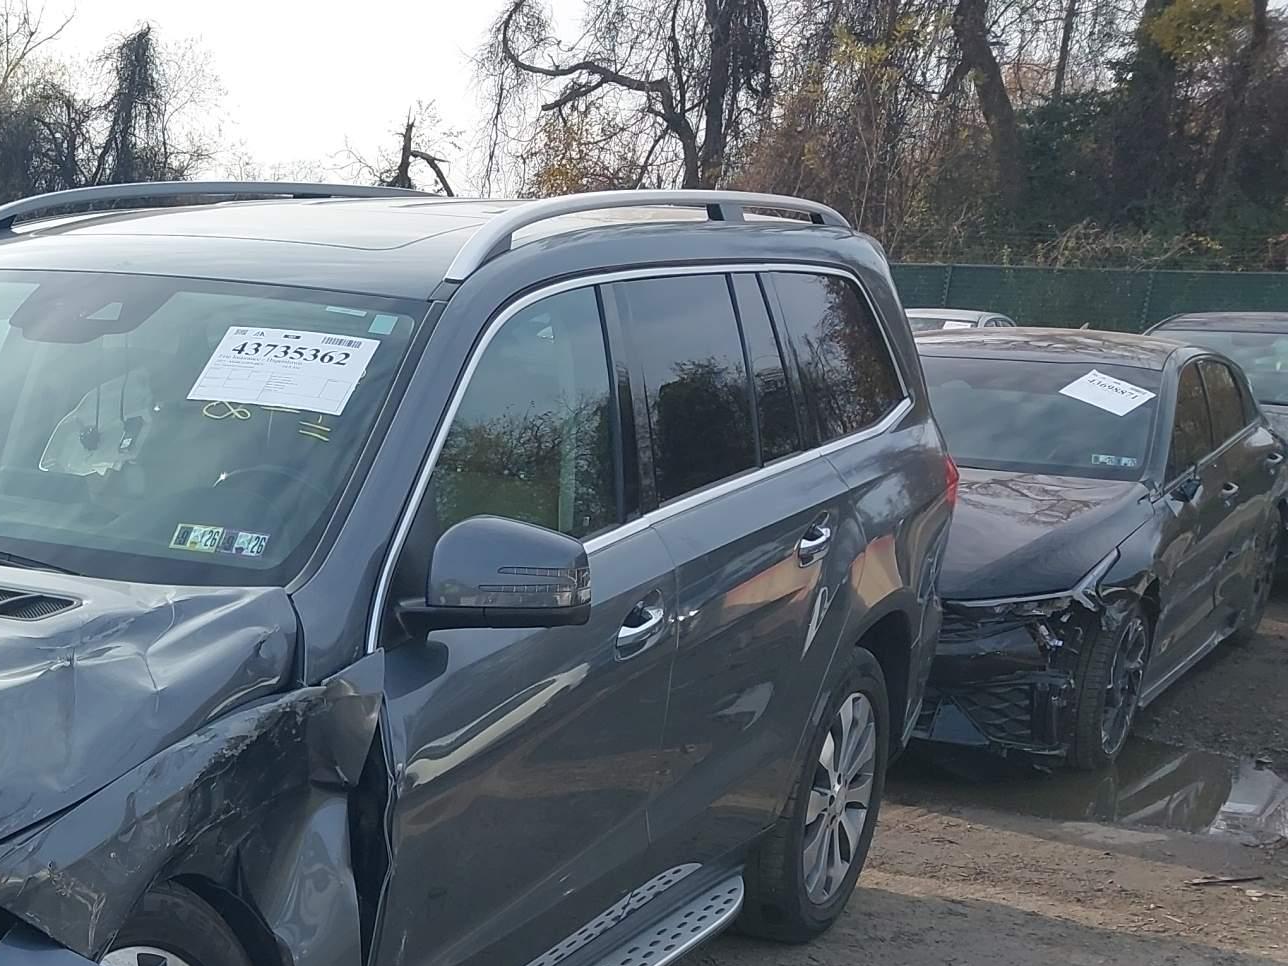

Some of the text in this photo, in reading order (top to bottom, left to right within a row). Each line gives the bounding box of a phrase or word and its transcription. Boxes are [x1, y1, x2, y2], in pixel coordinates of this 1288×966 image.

[232, 341, 351, 366] 43735362
[203, 530, 220, 548] 26
[249, 536, 267, 554] 26
